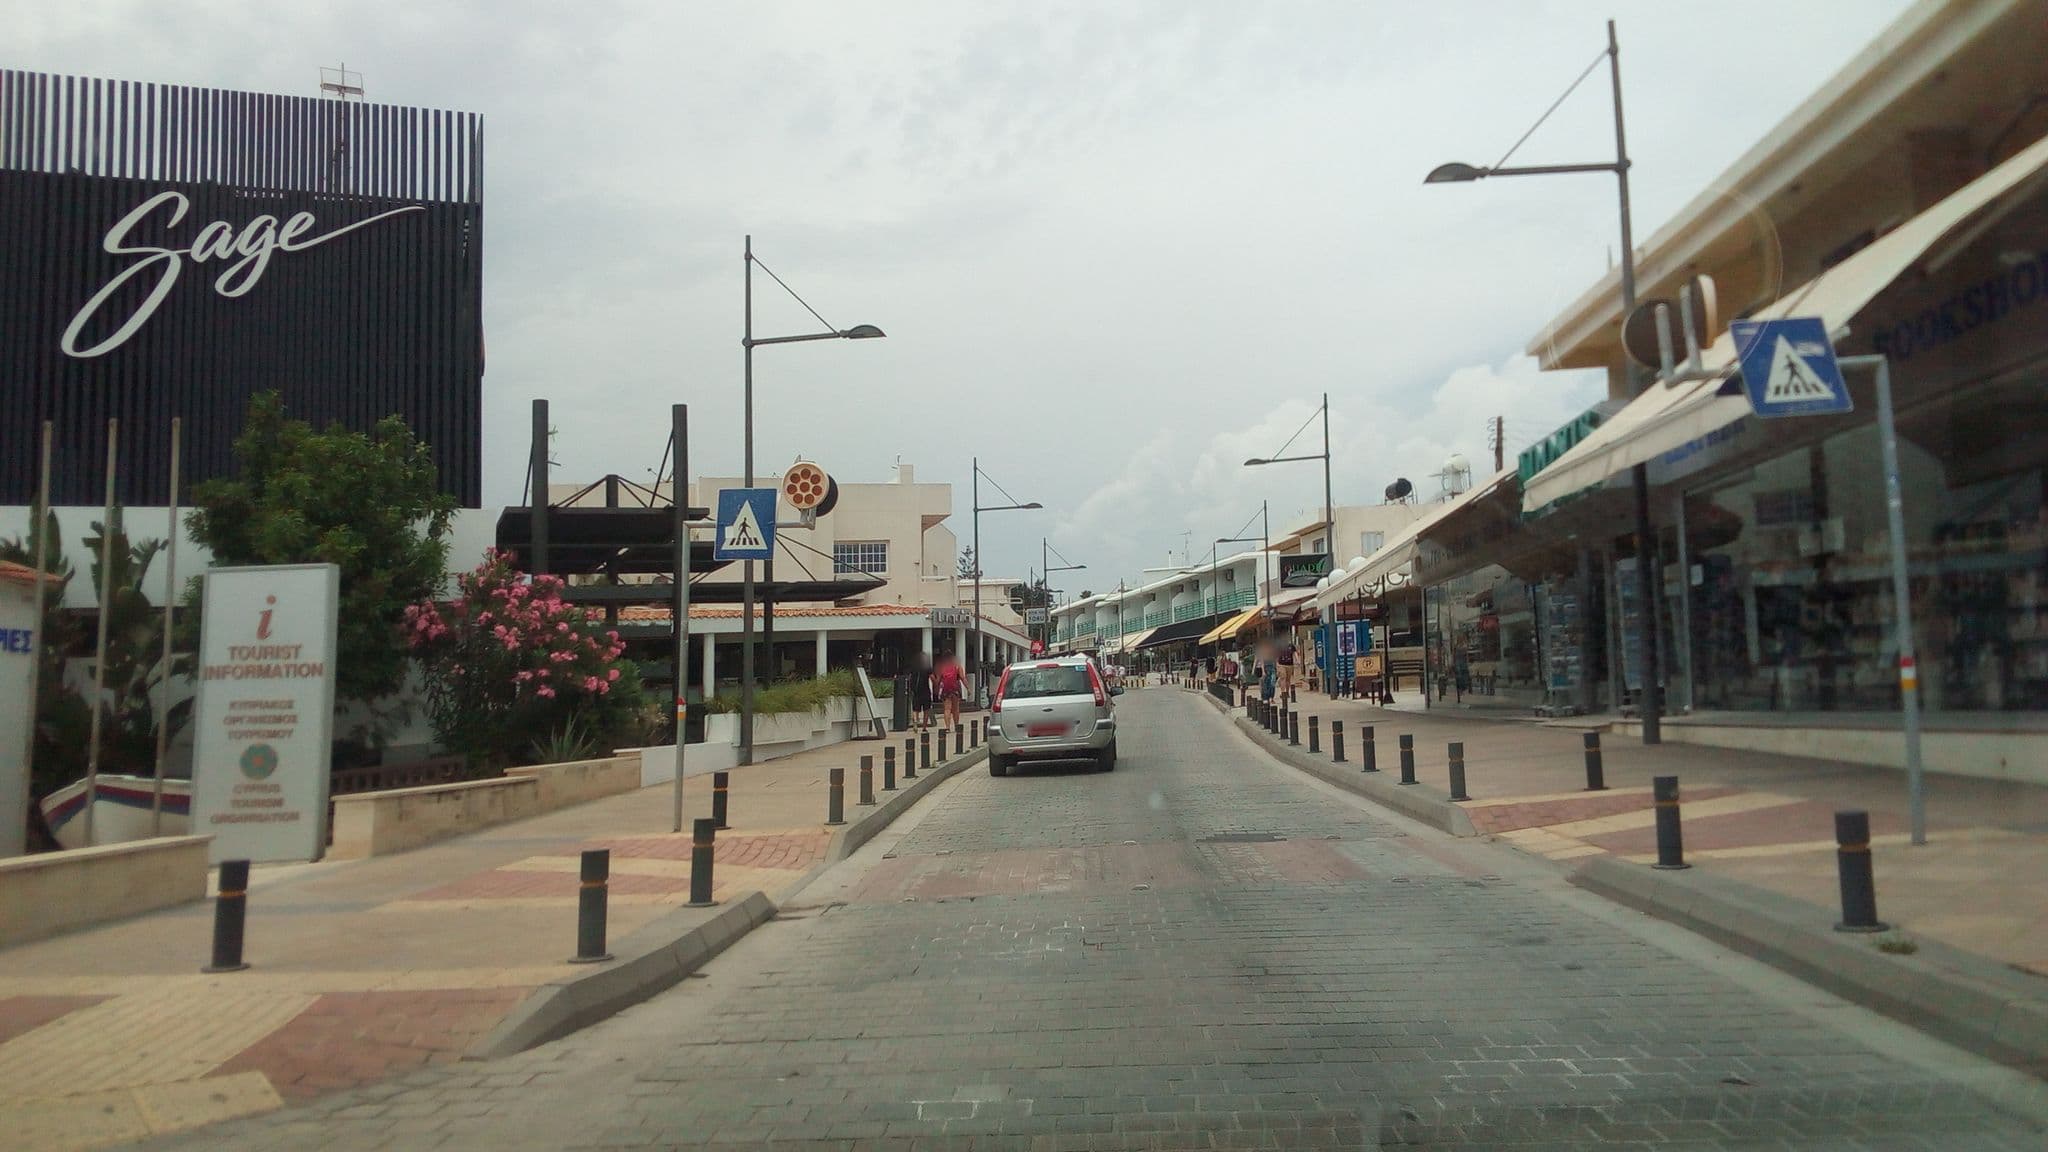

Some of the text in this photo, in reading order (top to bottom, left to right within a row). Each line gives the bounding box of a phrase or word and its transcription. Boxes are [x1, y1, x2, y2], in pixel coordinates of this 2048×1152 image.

[60, 190, 426, 359] Sage
[228, 643, 303, 661] TOURIST
[203, 661, 324, 681] INFORMATION
